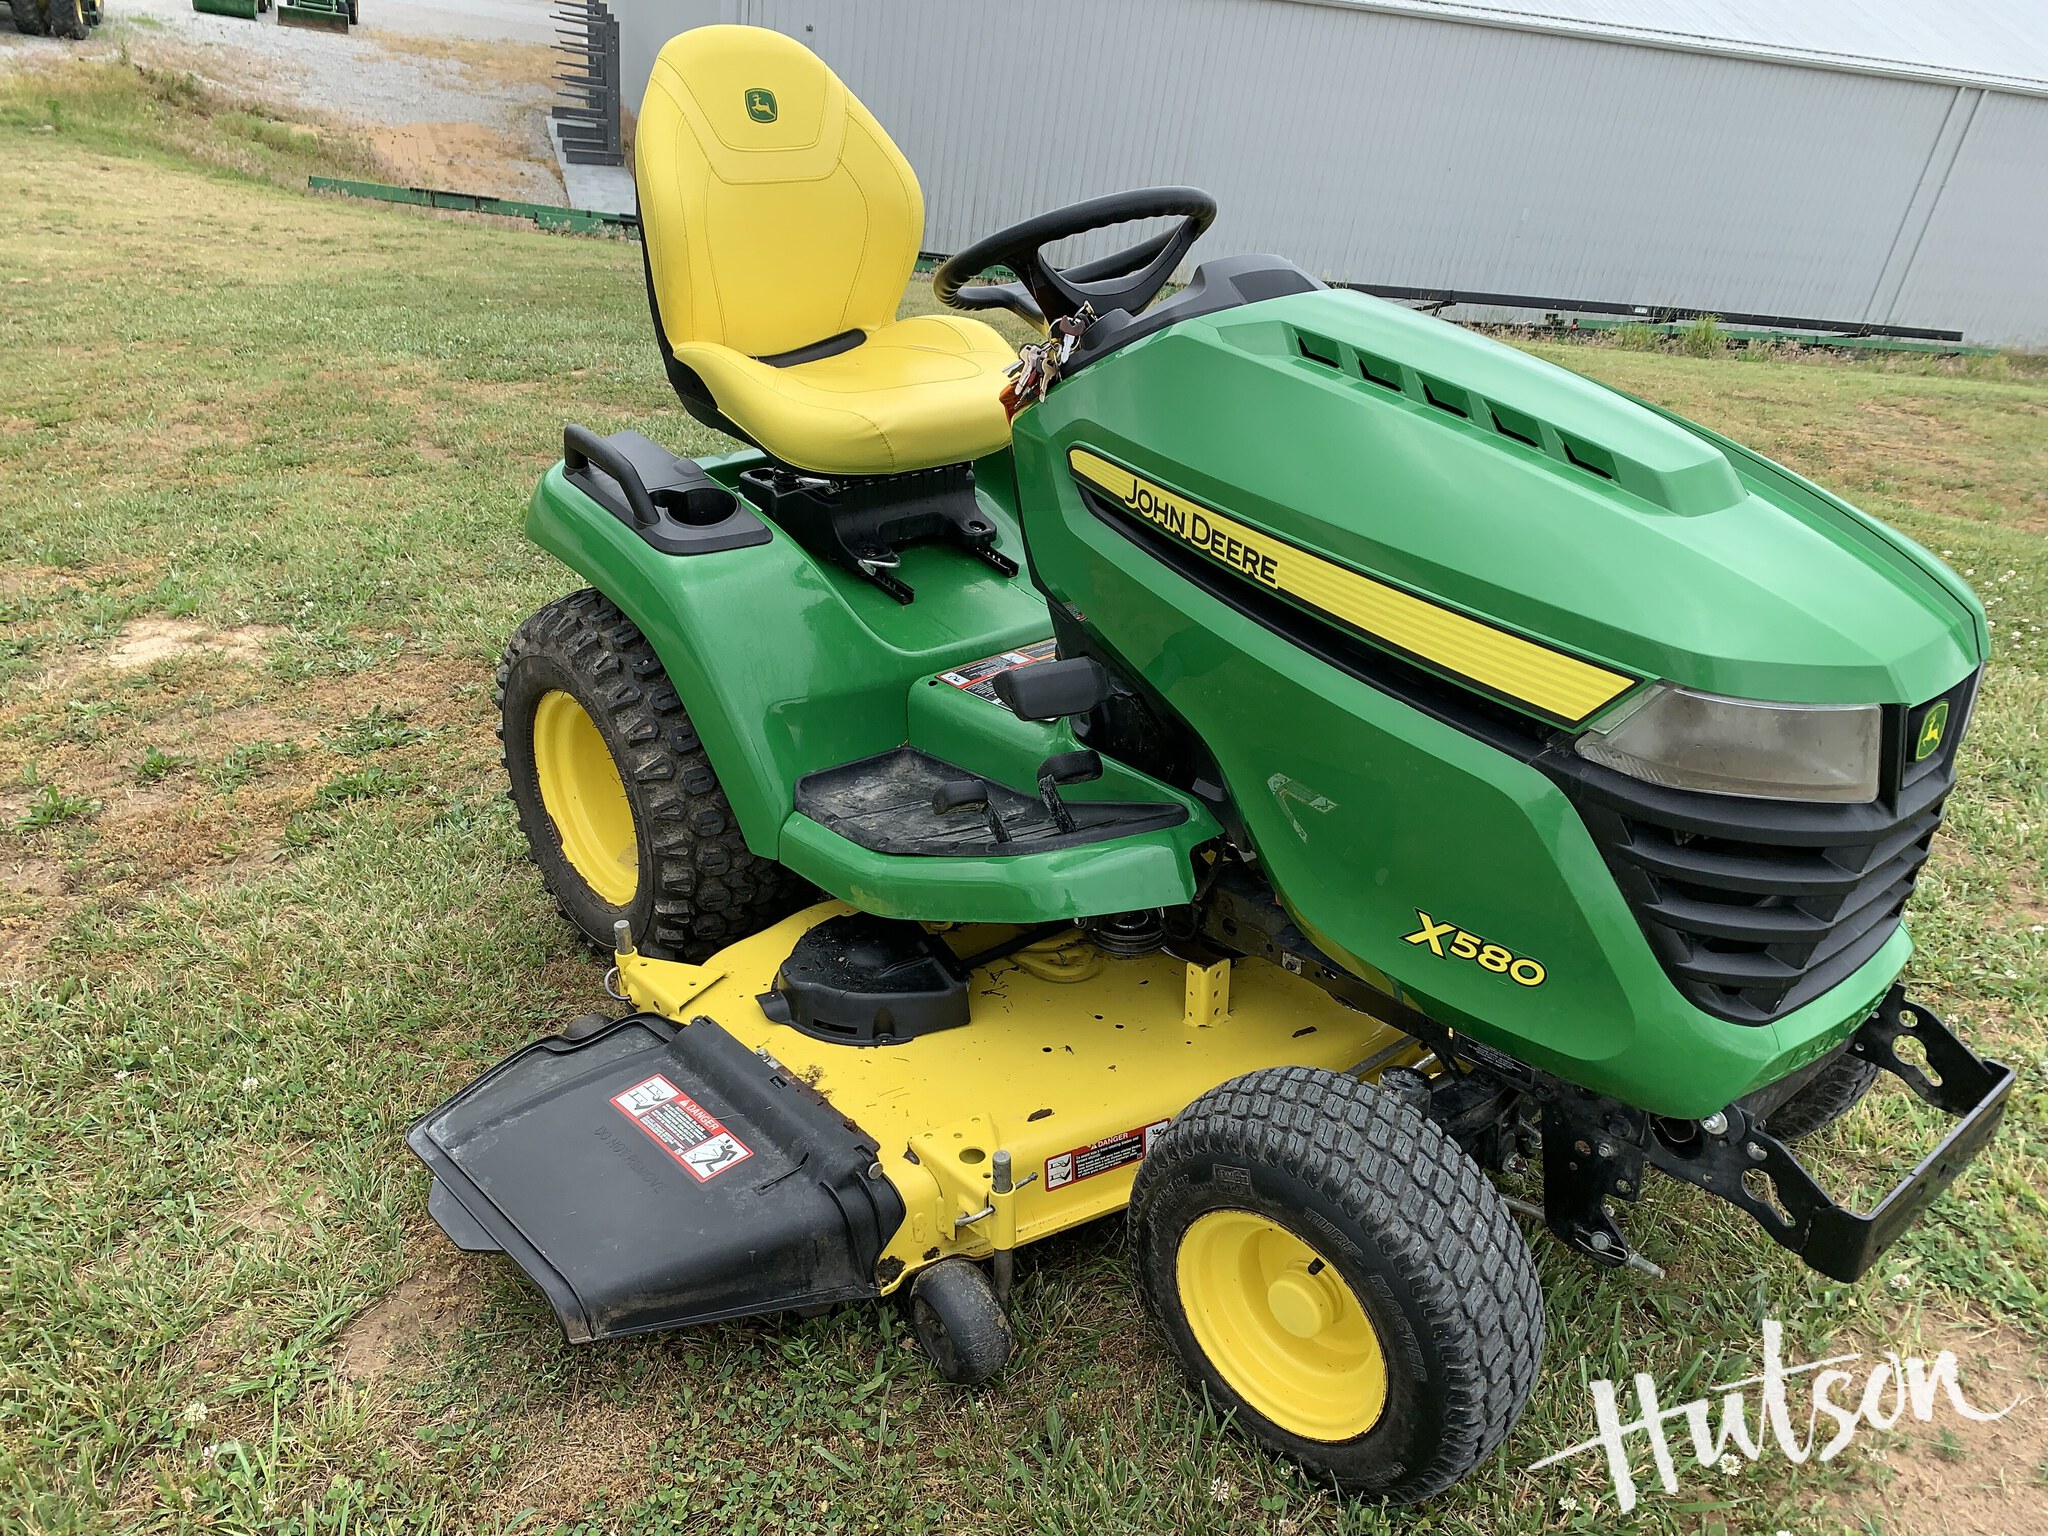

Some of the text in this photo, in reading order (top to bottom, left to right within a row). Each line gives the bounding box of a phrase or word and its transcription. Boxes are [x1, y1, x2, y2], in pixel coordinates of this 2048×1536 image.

[1125, 479, 1279, 586] JOHN DEERE
[1401, 909, 1547, 987] X580
[687, 1103, 720, 1131] DANGER
[1097, 1132, 1129, 1148] DANGER
[1304, 1206, 1428, 1383] TURF MASTER
